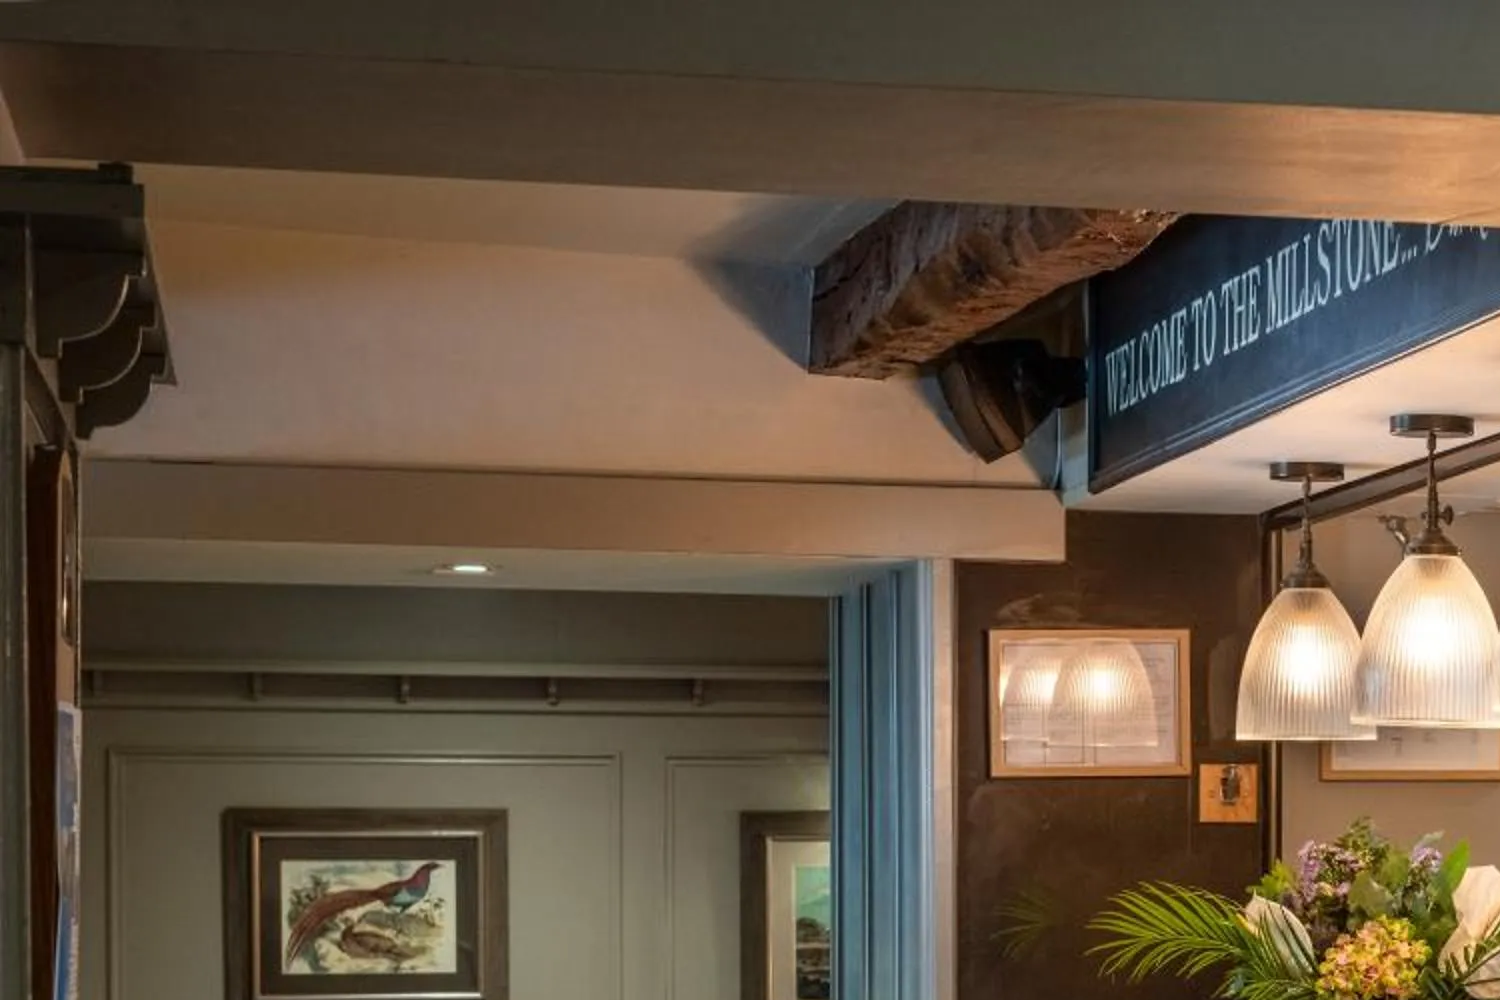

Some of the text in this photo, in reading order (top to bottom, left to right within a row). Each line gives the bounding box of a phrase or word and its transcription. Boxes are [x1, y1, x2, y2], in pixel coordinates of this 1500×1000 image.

[1105, 307, 1188, 417] WELCOME
[1191, 289, 1217, 371] TO
[1219, 265, 1262, 356] THE
